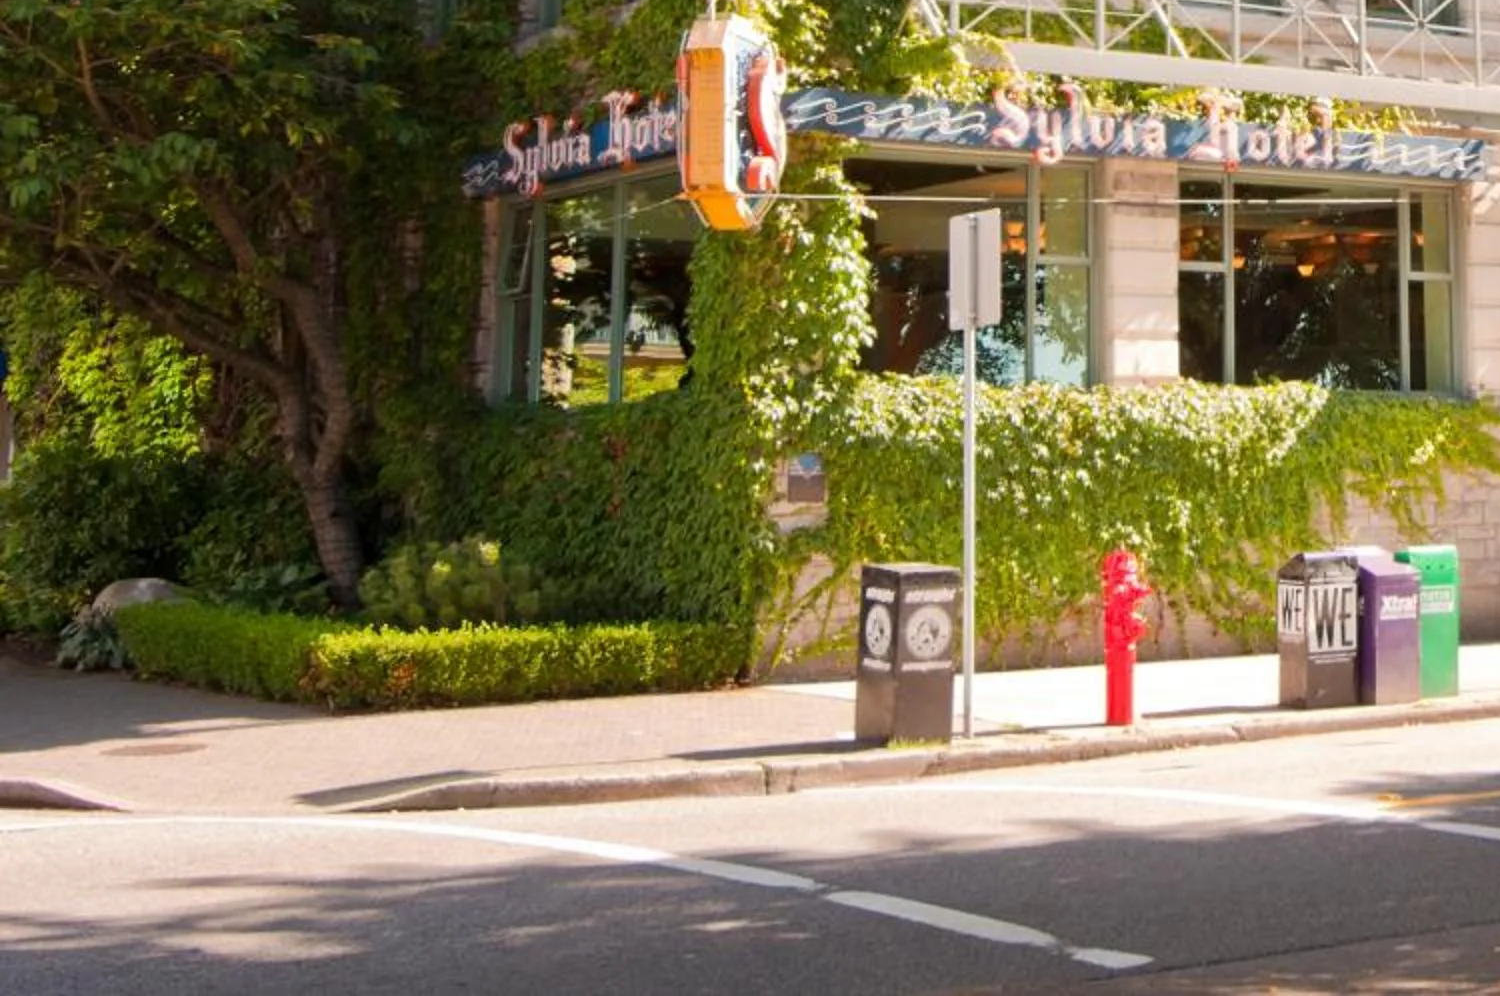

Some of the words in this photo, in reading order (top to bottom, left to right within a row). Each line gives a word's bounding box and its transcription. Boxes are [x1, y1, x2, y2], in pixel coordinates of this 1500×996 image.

[503, 115, 591, 198] Sylvia
[597, 90, 678, 171] Hote
[992, 81, 1168, 165] Sylvia
[1187, 92, 1335, 171] Hotel
[1312, 587, 1354, 649] WE
